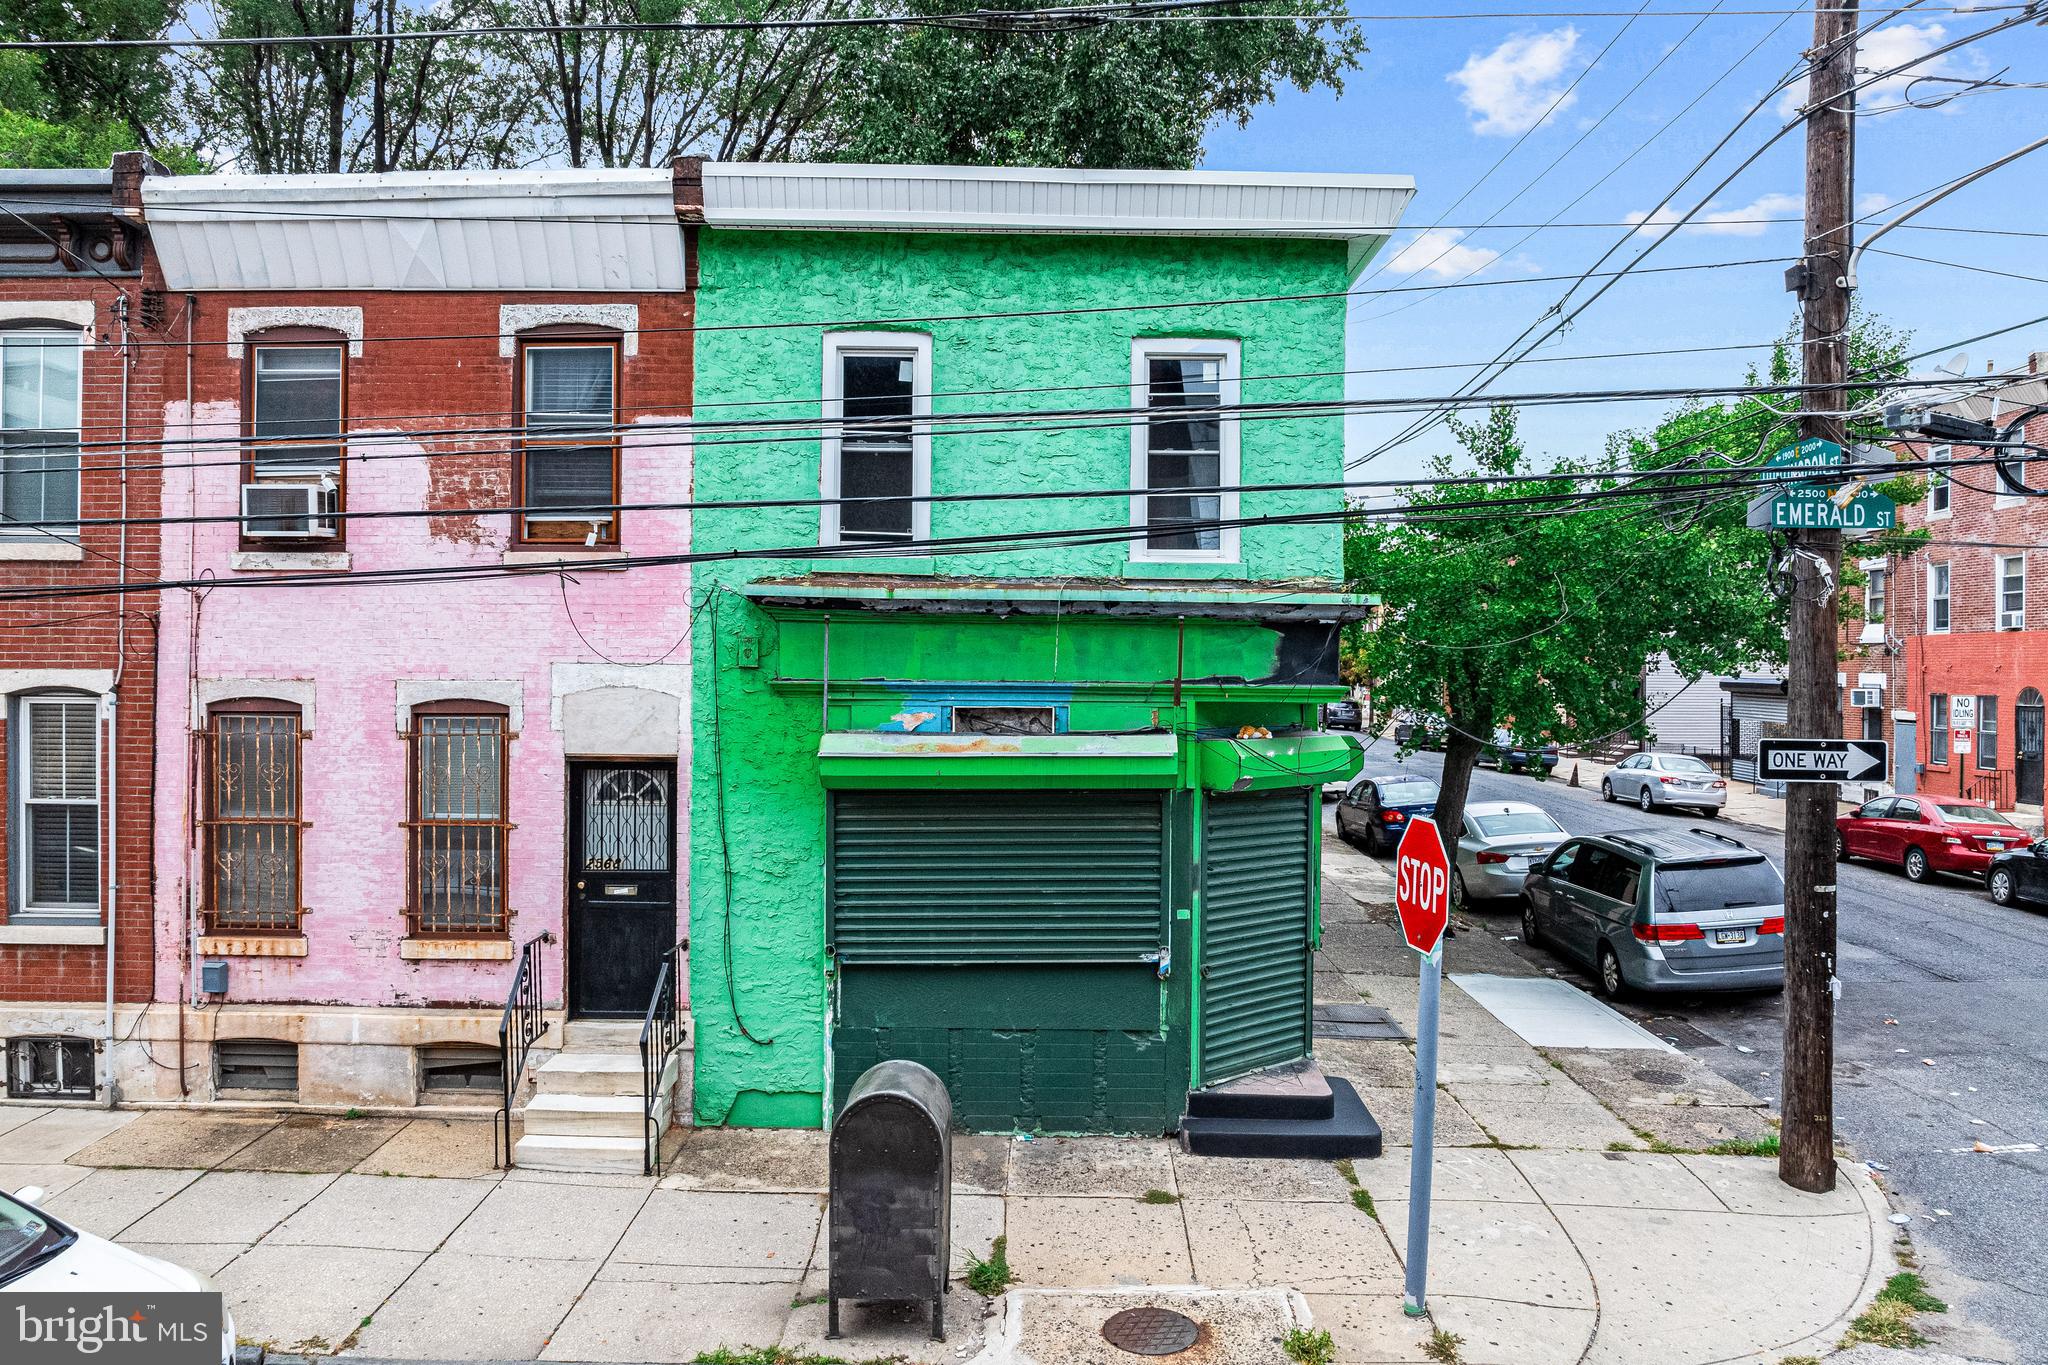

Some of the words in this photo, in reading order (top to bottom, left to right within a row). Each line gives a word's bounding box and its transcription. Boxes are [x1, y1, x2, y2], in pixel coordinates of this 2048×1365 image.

[1782, 449, 1795, 461] 1900
[1795, 446, 1800, 458] E
[1801, 442, 1817, 455] 2000
[1797, 489, 1826, 498] 2500
[1776, 502, 1865, 526] EMERALD
[1876, 511, 1891, 527] ST
[1957, 698, 1970, 707] NO
[1953, 709, 1974, 718] IDLING
[1773, 752, 1807, 768] ONE
[1813, 753, 1848, 769] WAY
[1400, 855, 1445, 914] STOP
